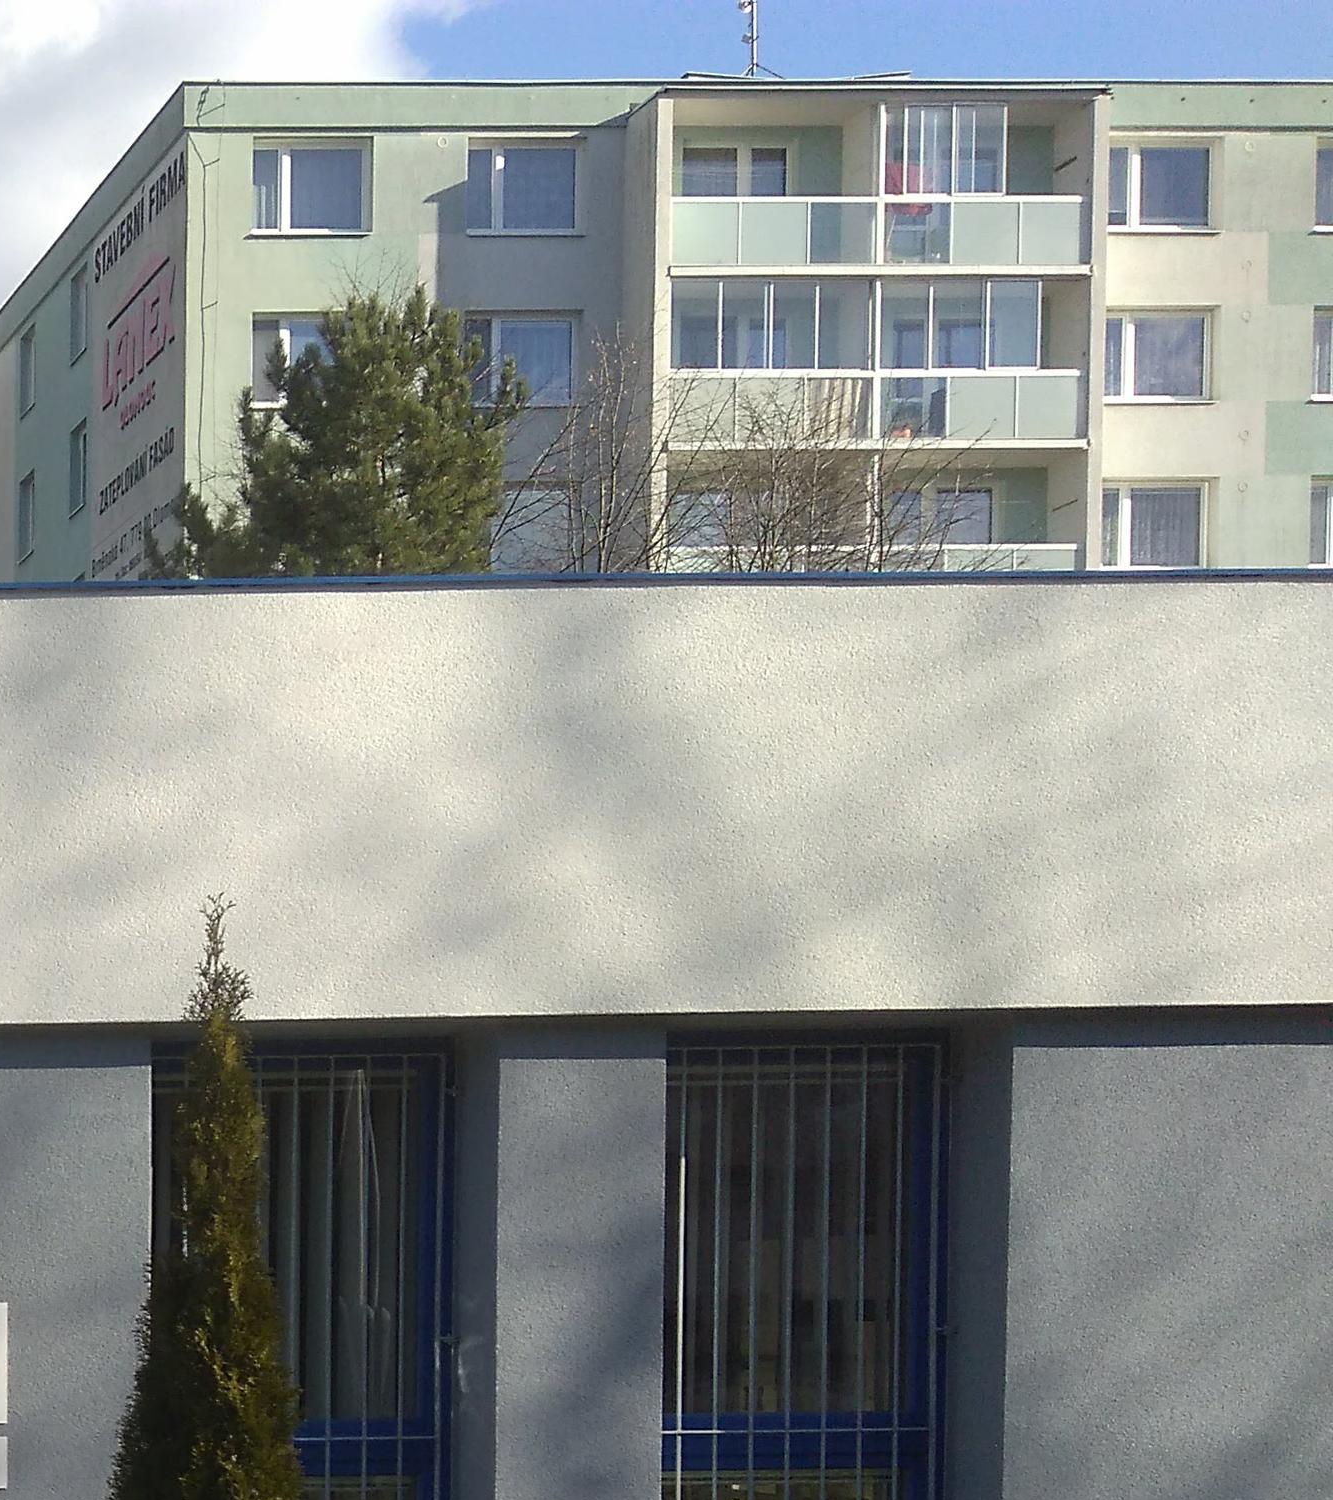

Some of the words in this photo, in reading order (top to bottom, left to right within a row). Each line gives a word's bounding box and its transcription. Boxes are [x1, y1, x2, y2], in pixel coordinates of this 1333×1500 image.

[94, 184, 146, 283] STAVEBNÍ
[148, 151, 185, 225] FIRMA
[99, 444, 148, 515] ZATEPLOVÁNÍ
[149, 426, 174, 472] FASÁD
